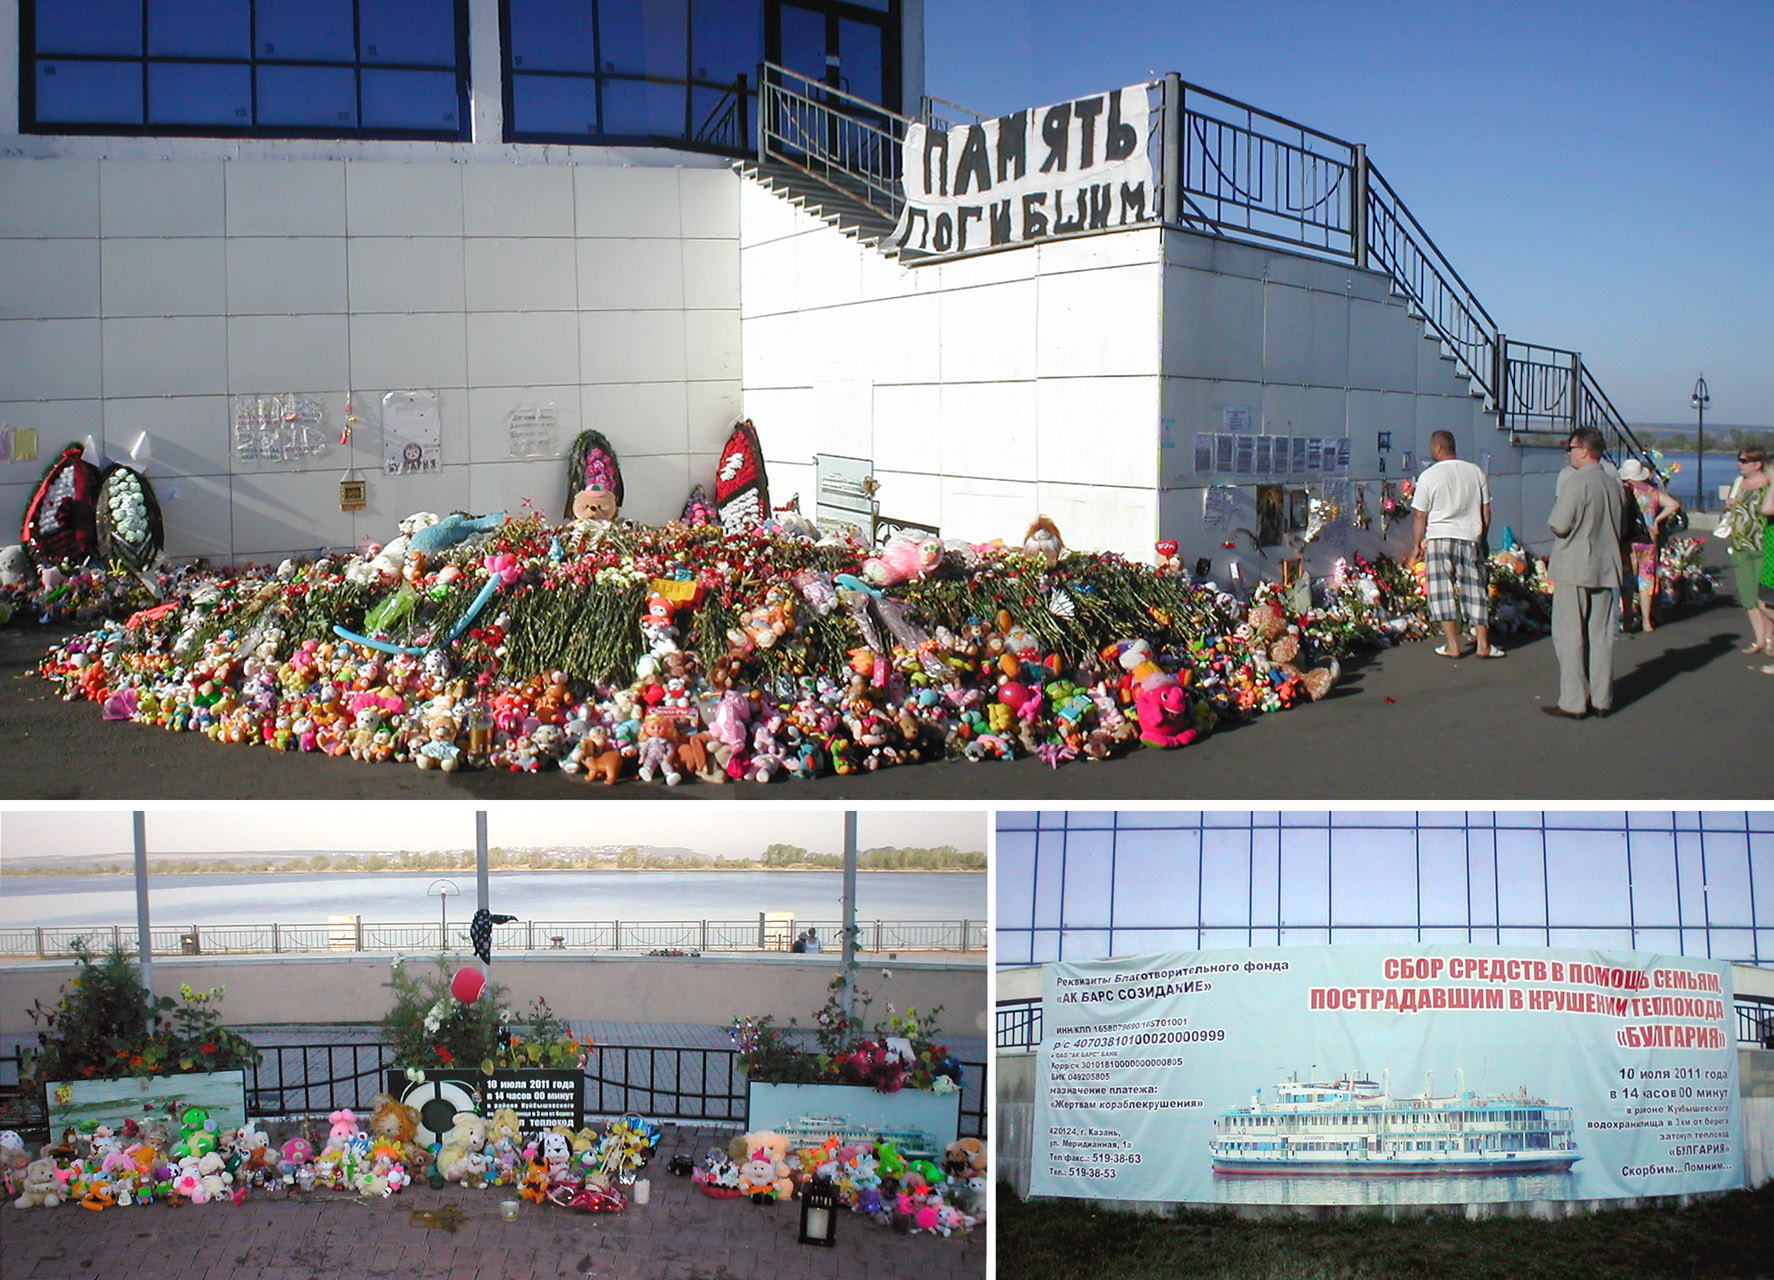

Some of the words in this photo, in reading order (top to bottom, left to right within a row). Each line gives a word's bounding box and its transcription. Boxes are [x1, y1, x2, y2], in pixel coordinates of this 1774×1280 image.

[924, 89, 1137, 196] ПАМЯТЬ
[897, 181, 1145, 251] ПОГИБШИМ
[1057, 977, 1111, 987] Реквизиты
[1114, 963, 1239, 983] Благотворительного
[1244, 961, 1289, 973] фонда
[1384, 958, 1444, 980] СБОР
[1449, 958, 1547, 982] СРЕДСТВ
[1552, 962, 1564, 982] В
[1570, 964, 1650, 992] ПОМОЩЬ
[1654, 970, 1722, 994] СЕМЬЯМ,
[1057, 993, 1077, 1003] «АК
[1081, 990, 1114, 1001] БАРС
[1118, 981, 1212, 1000] СОЗИДАНИЕ»
[1310, 988, 1504, 1012] ПОСТРАДАВШИМ
[1510, 990, 1523, 1010] В
[1529, 990, 1628, 1017] КРУШЕНИИ
[1632, 997, 1724, 1021] ТЕПЛОХОДА
[1074, 1030, 1225, 1048] 40703810100020000999
[1617, 1026, 1726, 1048] «БУЛГАРИЯ»
[1620, 1068, 1634, 1079] 10
[1675, 1068, 1700, 1079] 2011
[1705, 1070, 1727, 1080] года
[487, 1080, 497, 1088] 10
[530, 1080, 549, 1088] 2011
[553, 1081, 574, 1089] года
[495, 1092, 504, 1100] 14
[534, 1092, 545, 1100] 00
[1610, 1090, 1616, 1099] в
[1622, 1088, 1638, 1099] 14
[1679, 1087, 1692, 1098] 00
[1697, 1089, 1728, 1100] минут
[1051, 1101, 1096, 1110] «Жертвам
[1099, 1100, 1203, 1110] кораблекрушения»
[1588, 1120, 1663, 1130] водохранилища
[1088, 1128, 1120, 1137] Казань,
[1062, 1140, 1119, 1149] Меридианная,
[1669, 1144, 1729, 1156] «БУЛГАРИЯ»
[1092, 1154, 1141, 1163] 519-38-63
[1069, 1168, 1116, 1178] 519-38-53
[1622, 1164, 1683, 1177] Скорбим...
[1685, 1162, 1732, 1172] Помним...
